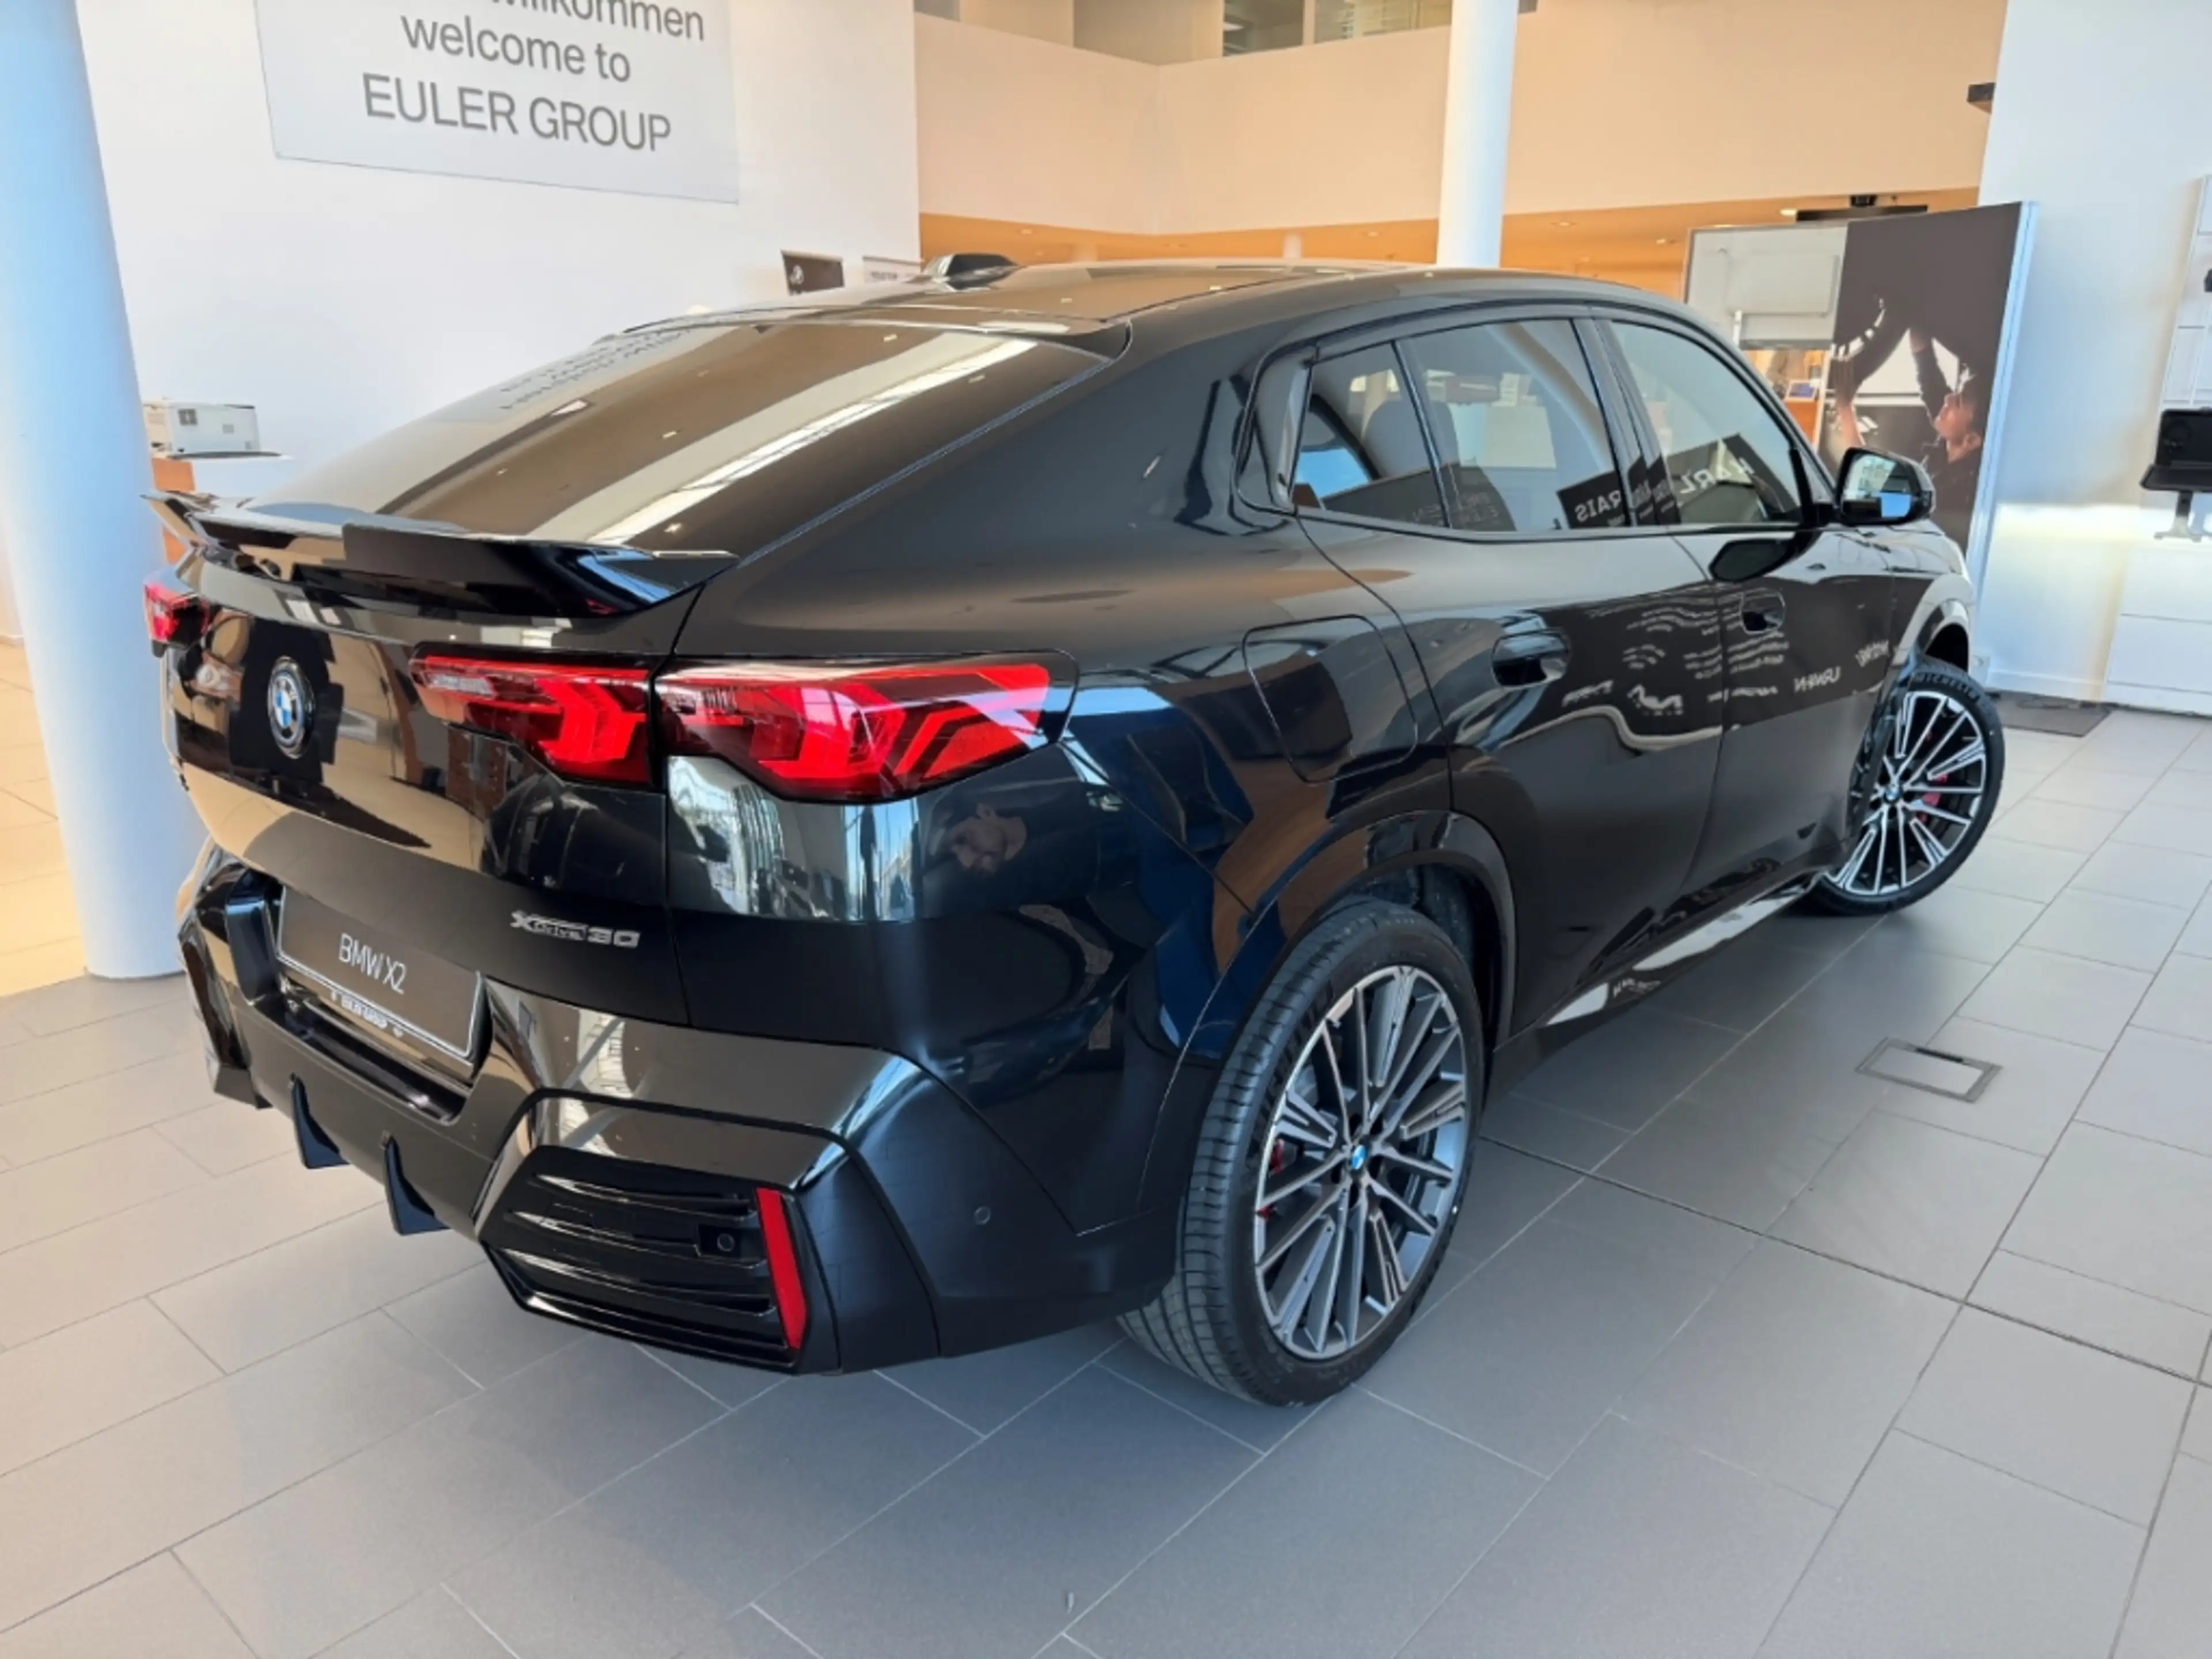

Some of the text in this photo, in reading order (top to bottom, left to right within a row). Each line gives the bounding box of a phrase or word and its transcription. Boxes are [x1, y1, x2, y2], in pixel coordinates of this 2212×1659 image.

[400, 14, 631, 82] welcome to
[492, 0, 704, 41] ommen
[362, 72, 672, 151] EULER GROUP
[338, 932, 407, 995] BMW X2
